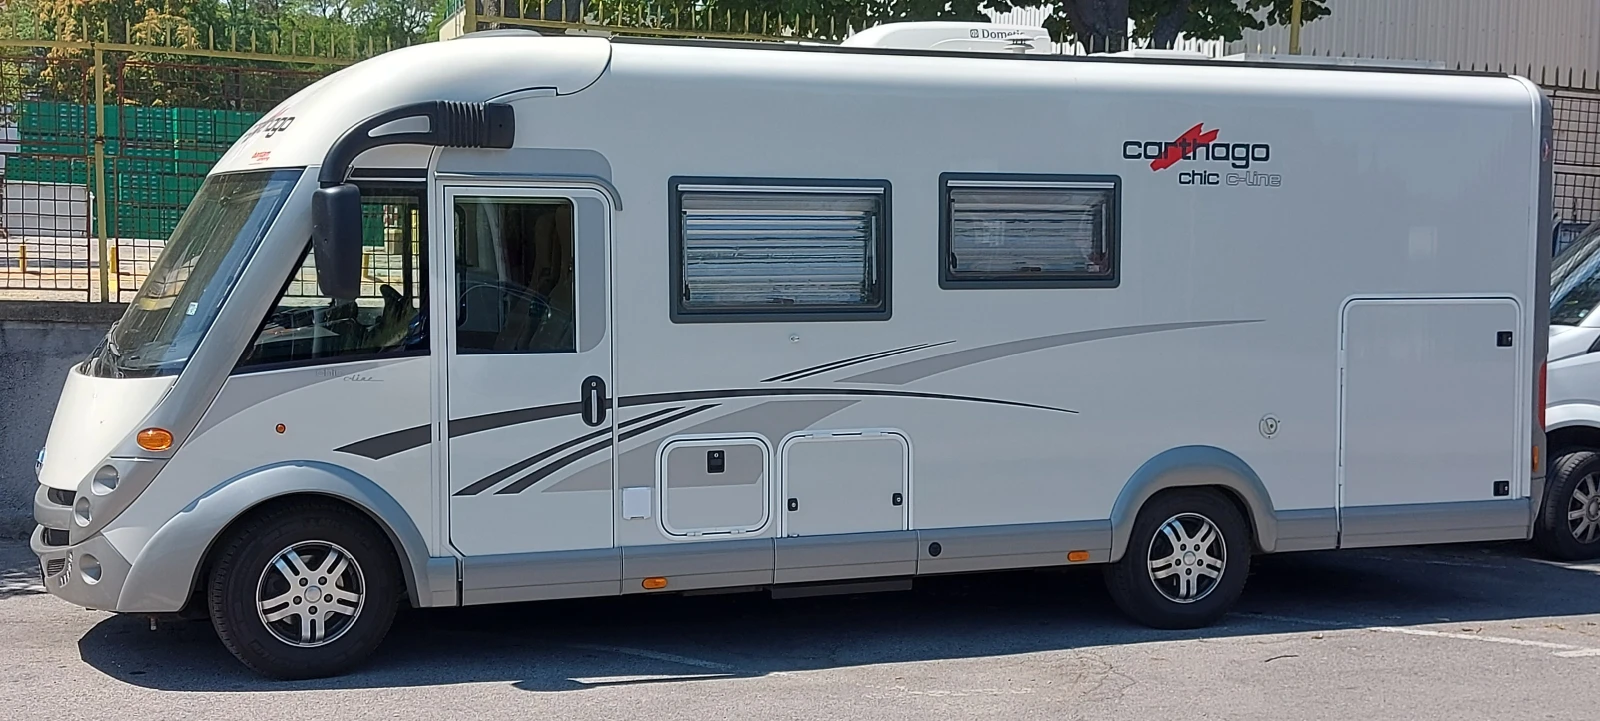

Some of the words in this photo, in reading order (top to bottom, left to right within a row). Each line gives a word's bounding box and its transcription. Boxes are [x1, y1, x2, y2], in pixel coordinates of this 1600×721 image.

[1123, 138, 1270, 169] carthago
[1178, 170, 1220, 185] chic
[1225, 171, 1282, 187] c-line
